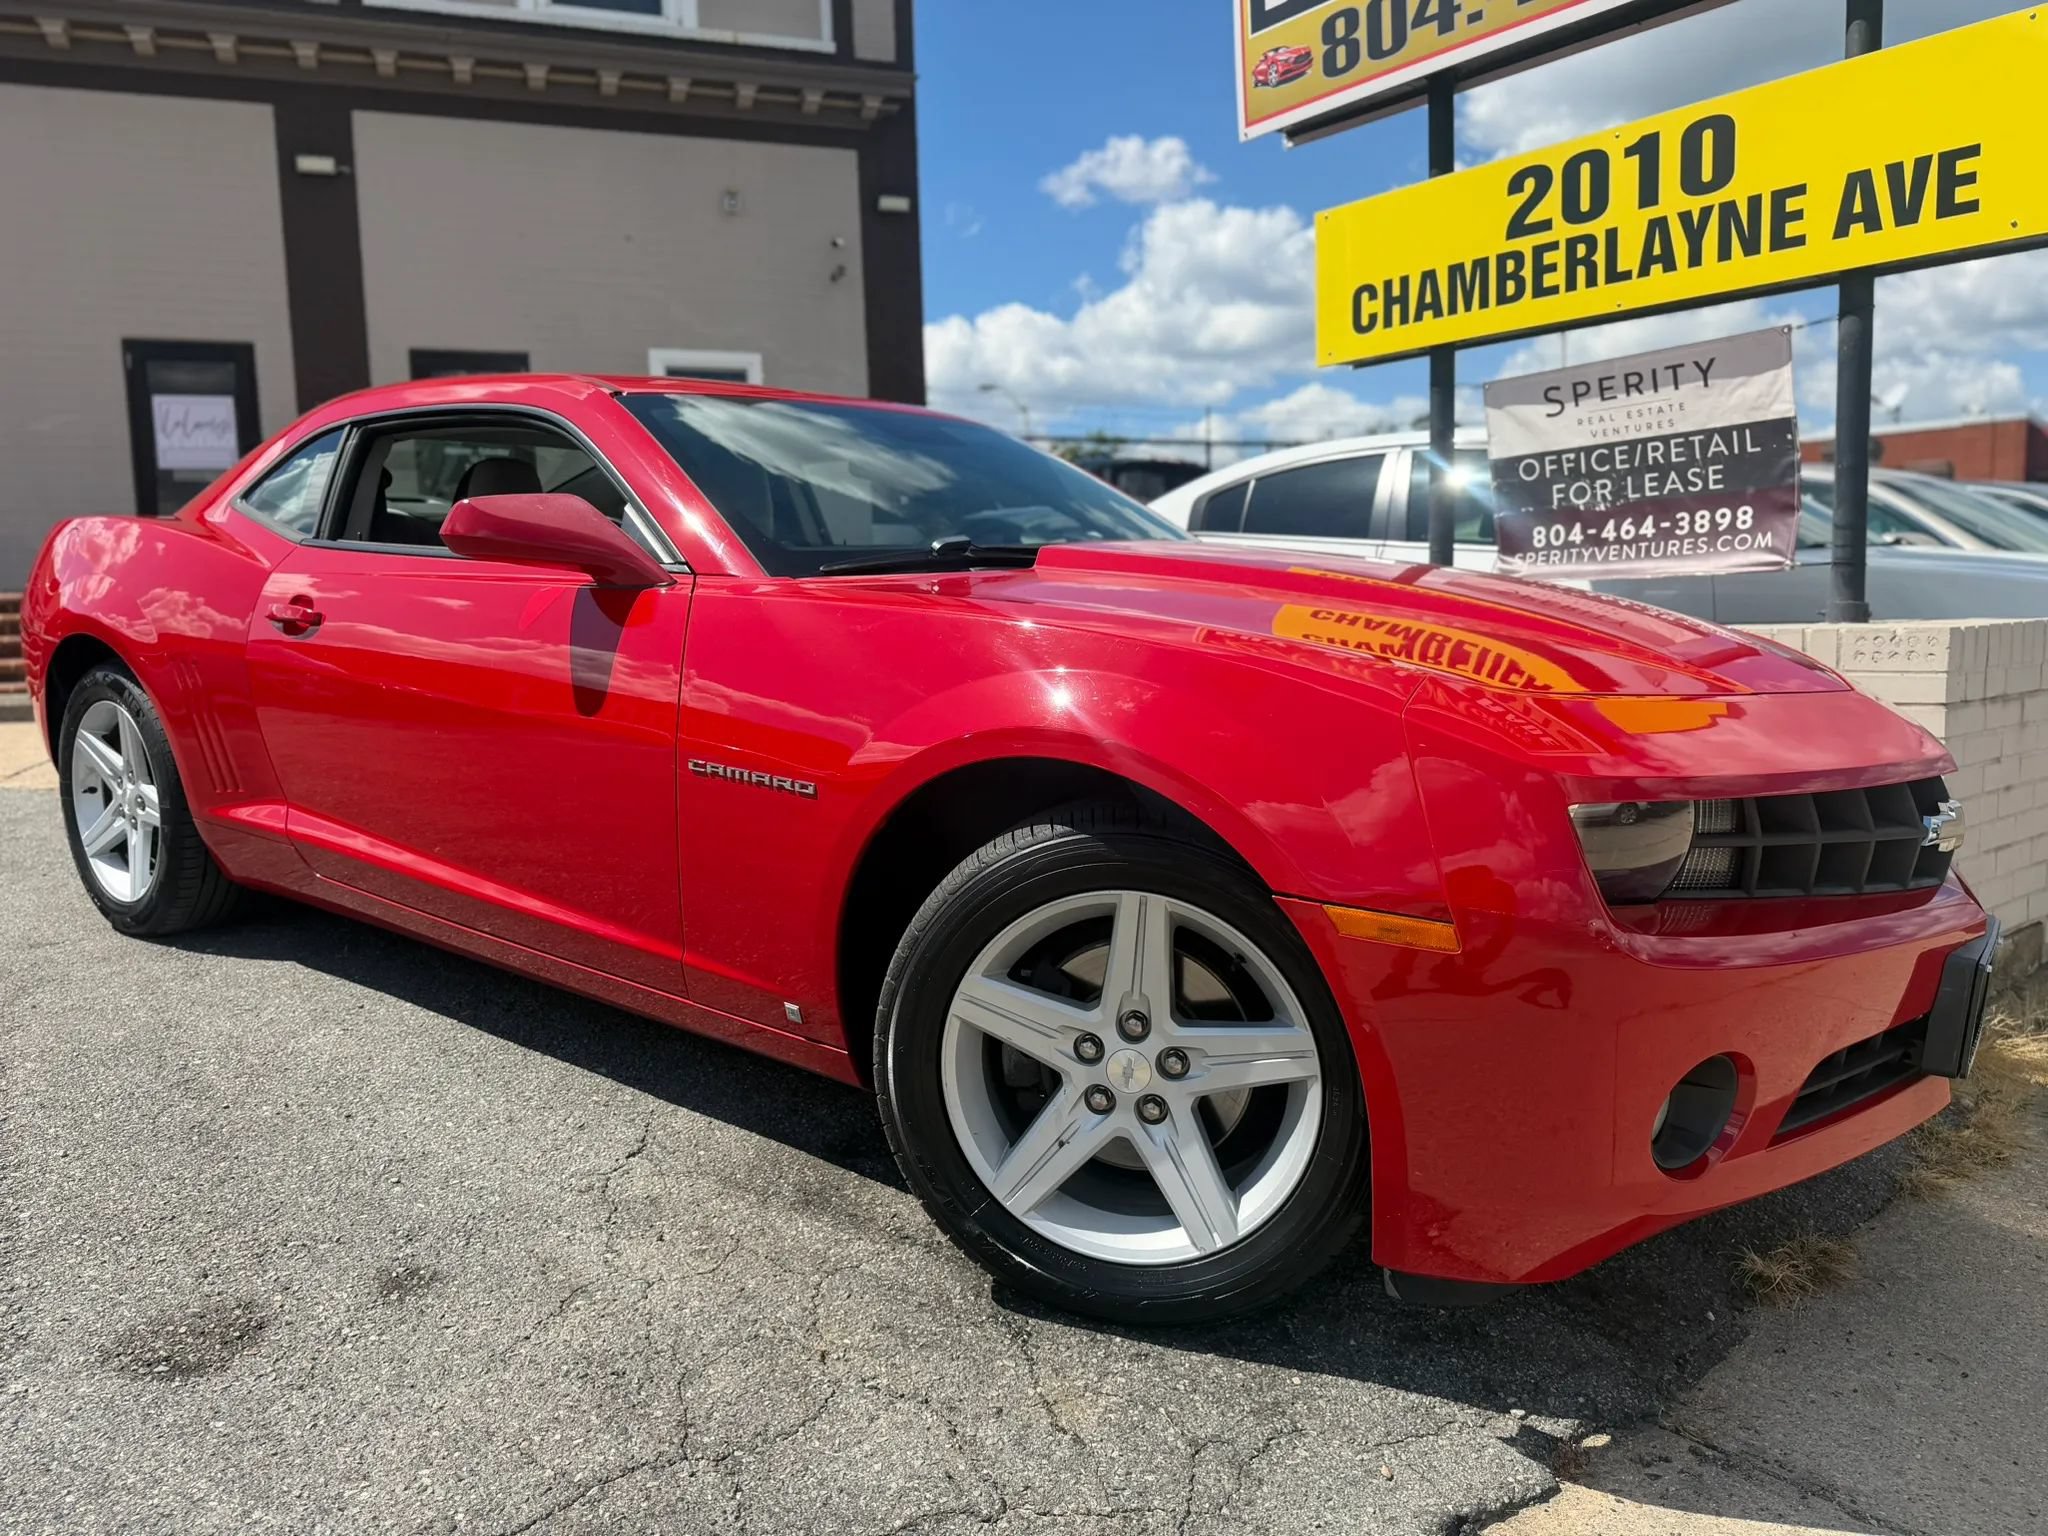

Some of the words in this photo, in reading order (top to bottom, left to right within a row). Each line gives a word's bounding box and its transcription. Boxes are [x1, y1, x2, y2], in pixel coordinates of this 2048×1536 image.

[1321, 0, 1531, 79] 804.
[1504, 114, 1737, 240] 2010
[1351, 182, 1808, 335] CHAMBERLAYNE
[1831, 142, 1982, 241] AVE
[1543, 357, 1717, 418] SPERITY
[1577, 412, 1616, 426] REAL
[1626, 401, 1687, 420] ESTATE
[1590, 418, 1676, 439] VENTURES
[1518, 428, 1762, 482] OFFICE/RETAIL
[1551, 480, 1613, 508] FOR
[1626, 464, 1725, 499] LEASE
[1531, 505, 1754, 549] 804-464-3898
[1514, 531, 1773, 568] SPERITYVENTURES.COM
[688, 758, 817, 797] CAMARO
